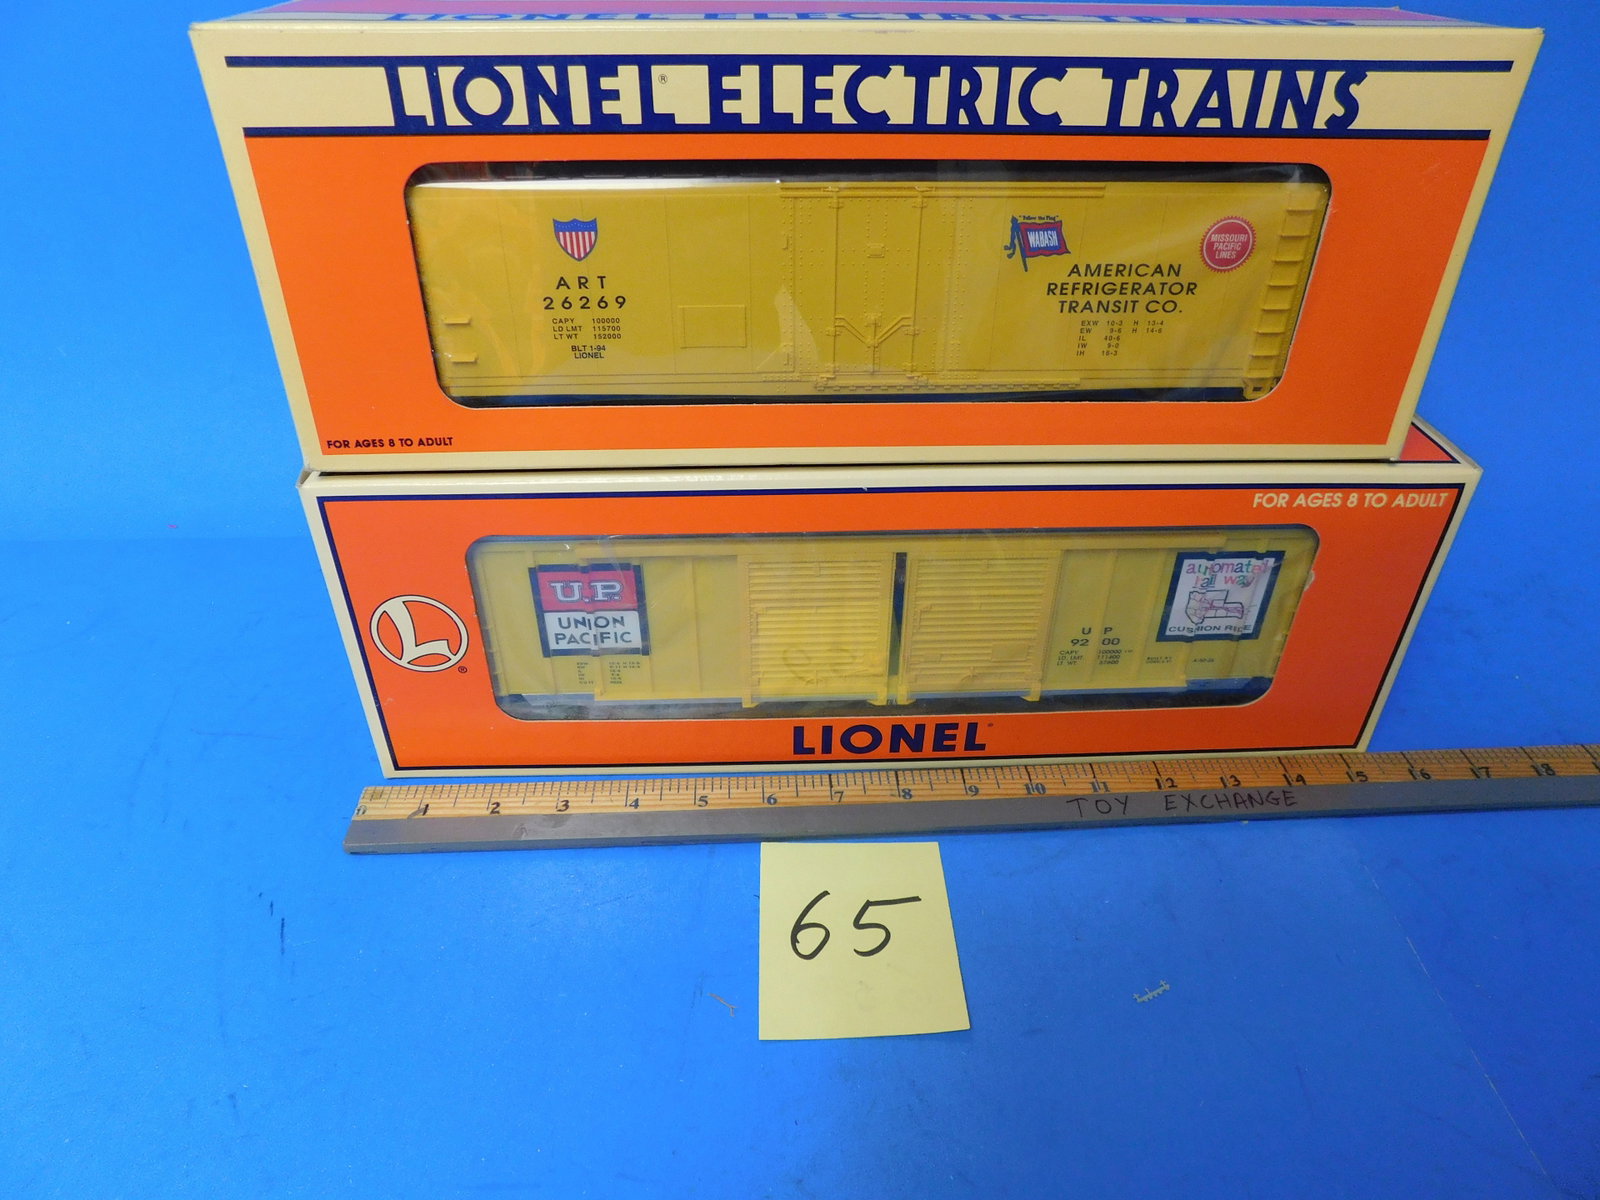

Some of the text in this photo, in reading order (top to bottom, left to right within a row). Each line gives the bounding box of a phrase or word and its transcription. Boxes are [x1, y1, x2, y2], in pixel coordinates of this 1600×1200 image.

[385, 63, 1368, 131] LIONEL ELECTRIC TRAINS
[1027, 230, 1058, 248] WABASH
[1210, 233, 1248, 242] MISSOURI
[1213, 242, 1242, 251] PACIFIC
[1215, 250, 1237, 259] LINES
[1067, 263, 1182, 277] AMERICAN
[1046, 281, 1198, 296] REFRIGERATOR
[543, 295, 627, 310] 26269
[1058, 299, 1182, 314] TRANSIT CO.
[326, 436, 453, 449] FOR AGES 8 TO ADULT
[1252, 492, 1449, 508] FOR AGES 8 TO ADULT
[557, 615, 625, 631] UNION
[553, 631, 632, 646] PACIFIC
[792, 722, 986, 755] LIONEL
[420, 803, 430, 816] 1
[489, 801, 501, 815] 2
[556, 799, 570, 813] 3
[628, 797, 640, 810] 4
[697, 795, 709, 808] 5
[766, 793, 778, 806] 6
[833, 790, 845, 803] 7
[901, 788, 913, 800] 8
[967, 784, 980, 797] 9
[1024, 782, 1047, 795] 10
[1089, 780, 1112, 793] 11
[1155, 777, 1178, 790] 12
[1219, 775, 1242, 788] 13
[1282, 772, 1308, 787] 14
[1345, 769, 1369, 783] 15
[1408, 767, 1432, 782] 16
[1469, 766, 1492, 779] 17
[1531, 763, 1556, 777] 18
[1065, 789, 1298, 818] TOY EXCHANGE
[790, 889, 922, 961] 65
